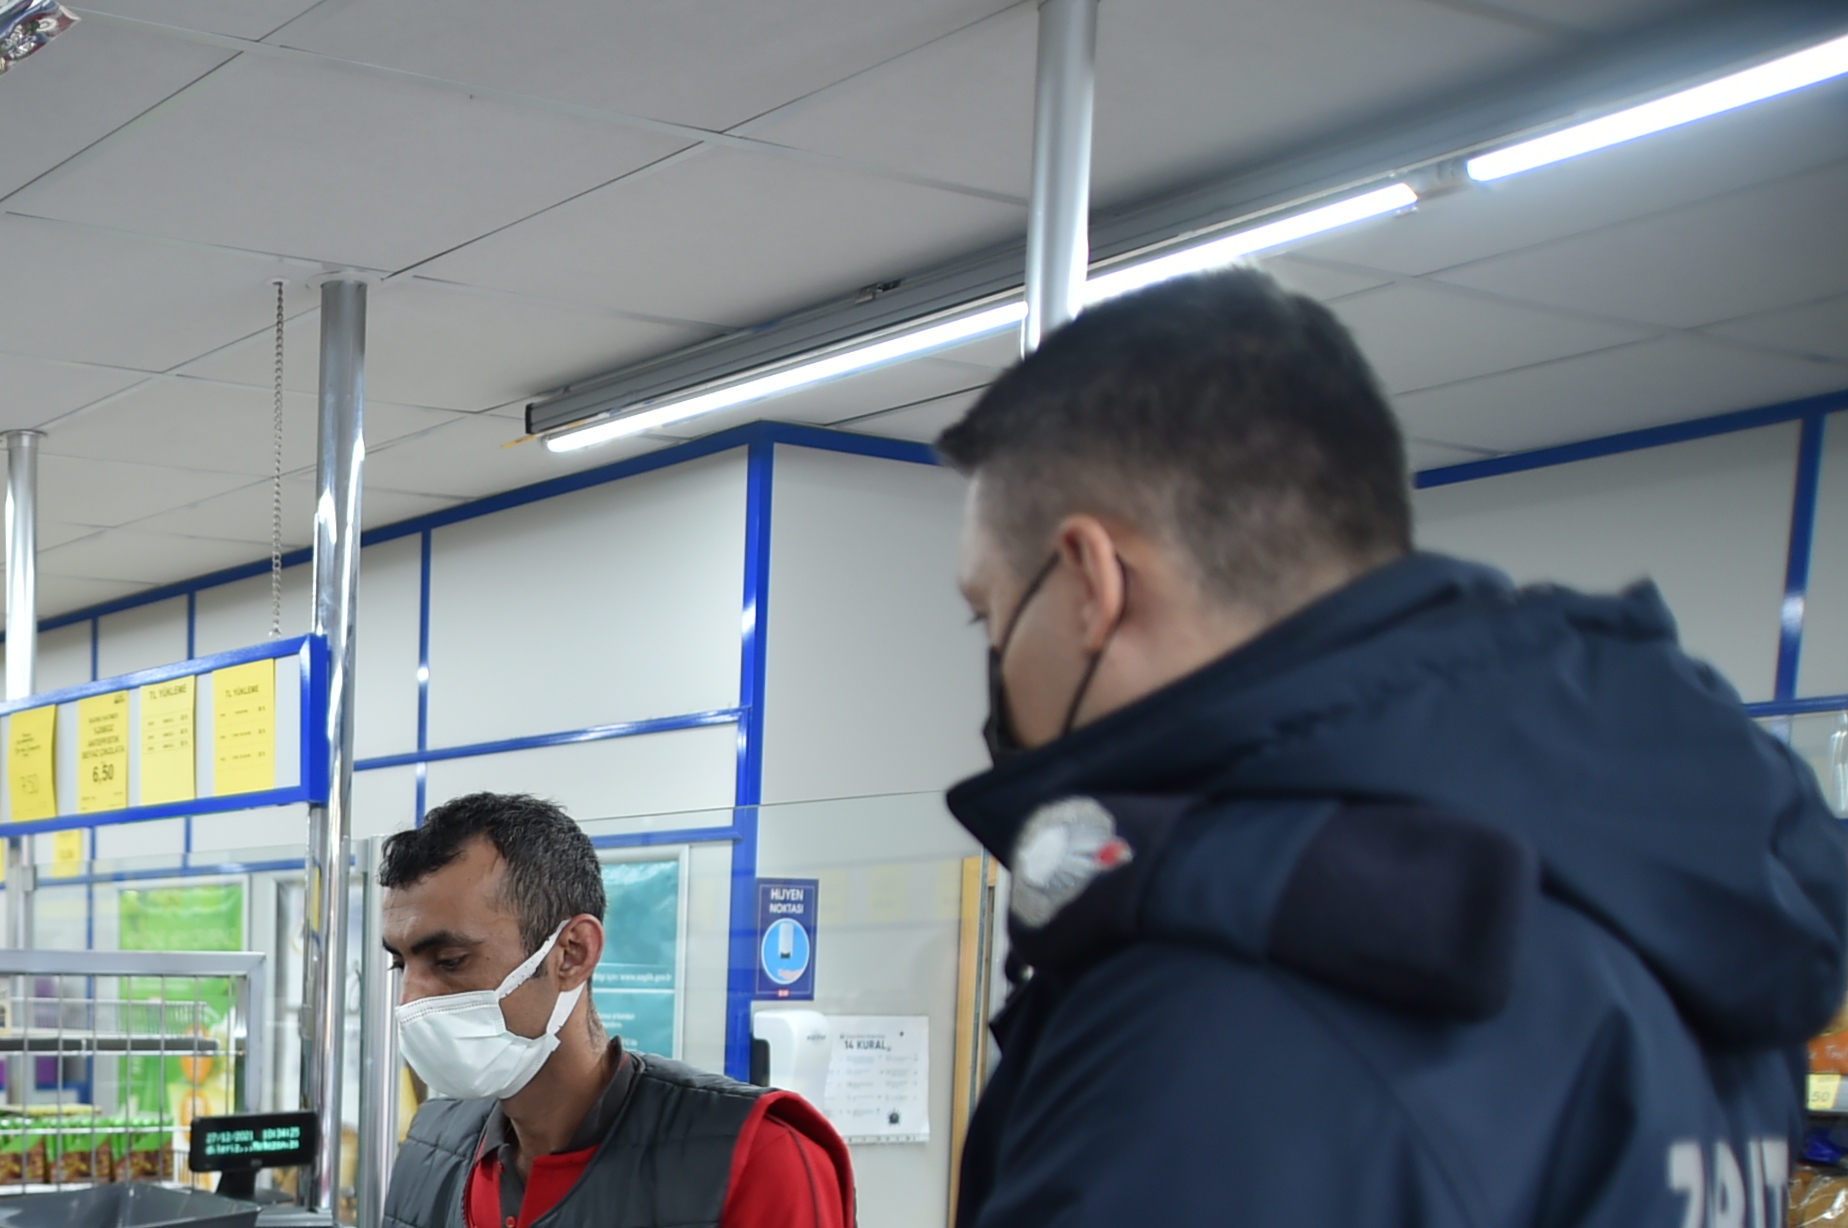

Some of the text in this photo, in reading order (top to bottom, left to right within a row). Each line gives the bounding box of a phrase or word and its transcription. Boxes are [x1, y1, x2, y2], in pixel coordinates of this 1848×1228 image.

[92, 763, 114, 783] 6,50
[844, 1040, 886, 1050] 14 KURAL
